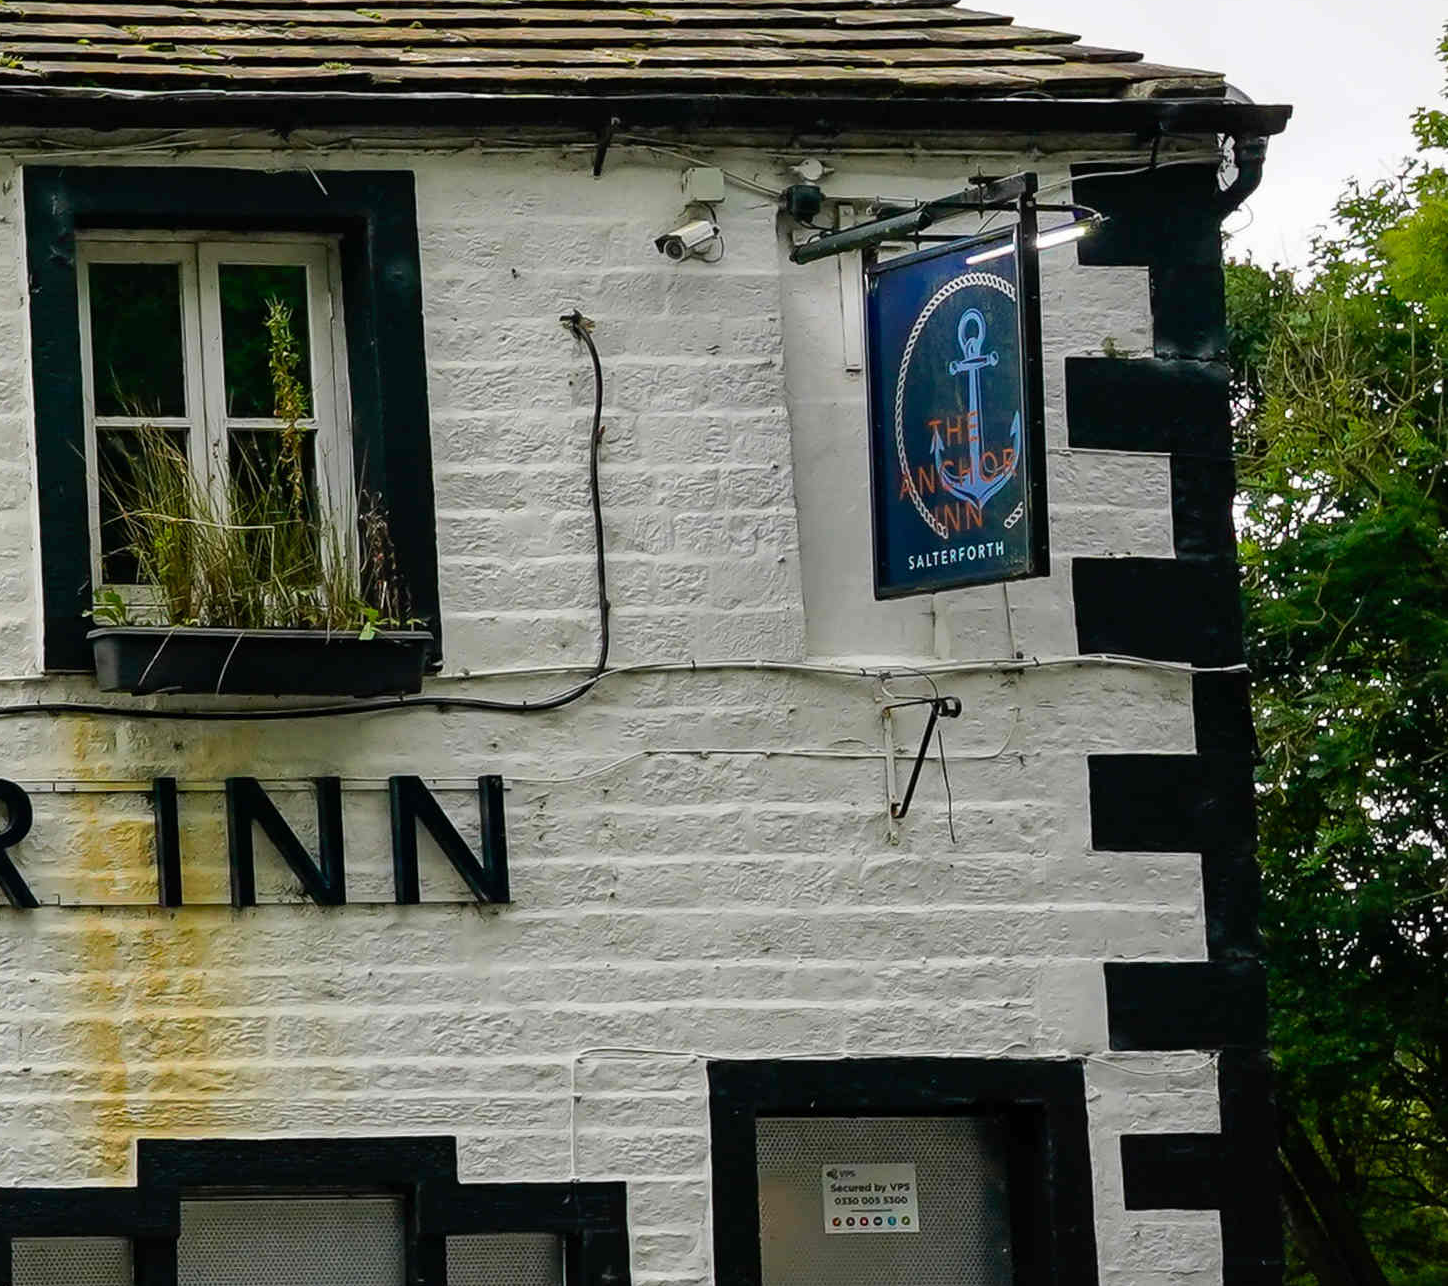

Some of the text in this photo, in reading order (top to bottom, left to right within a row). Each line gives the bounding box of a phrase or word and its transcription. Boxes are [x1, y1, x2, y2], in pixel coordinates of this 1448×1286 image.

[928, 411, 979, 446] THE
[899, 448, 1018, 500] ANCHOR
[934, 499, 983, 532] INN
[908, 541, 1005, 570] SALTERFORTH
[152, 774, 512, 909] INN
[830, 1183, 910, 1193] Secured by VPS
[834, 1197, 859, 1205] 0330
